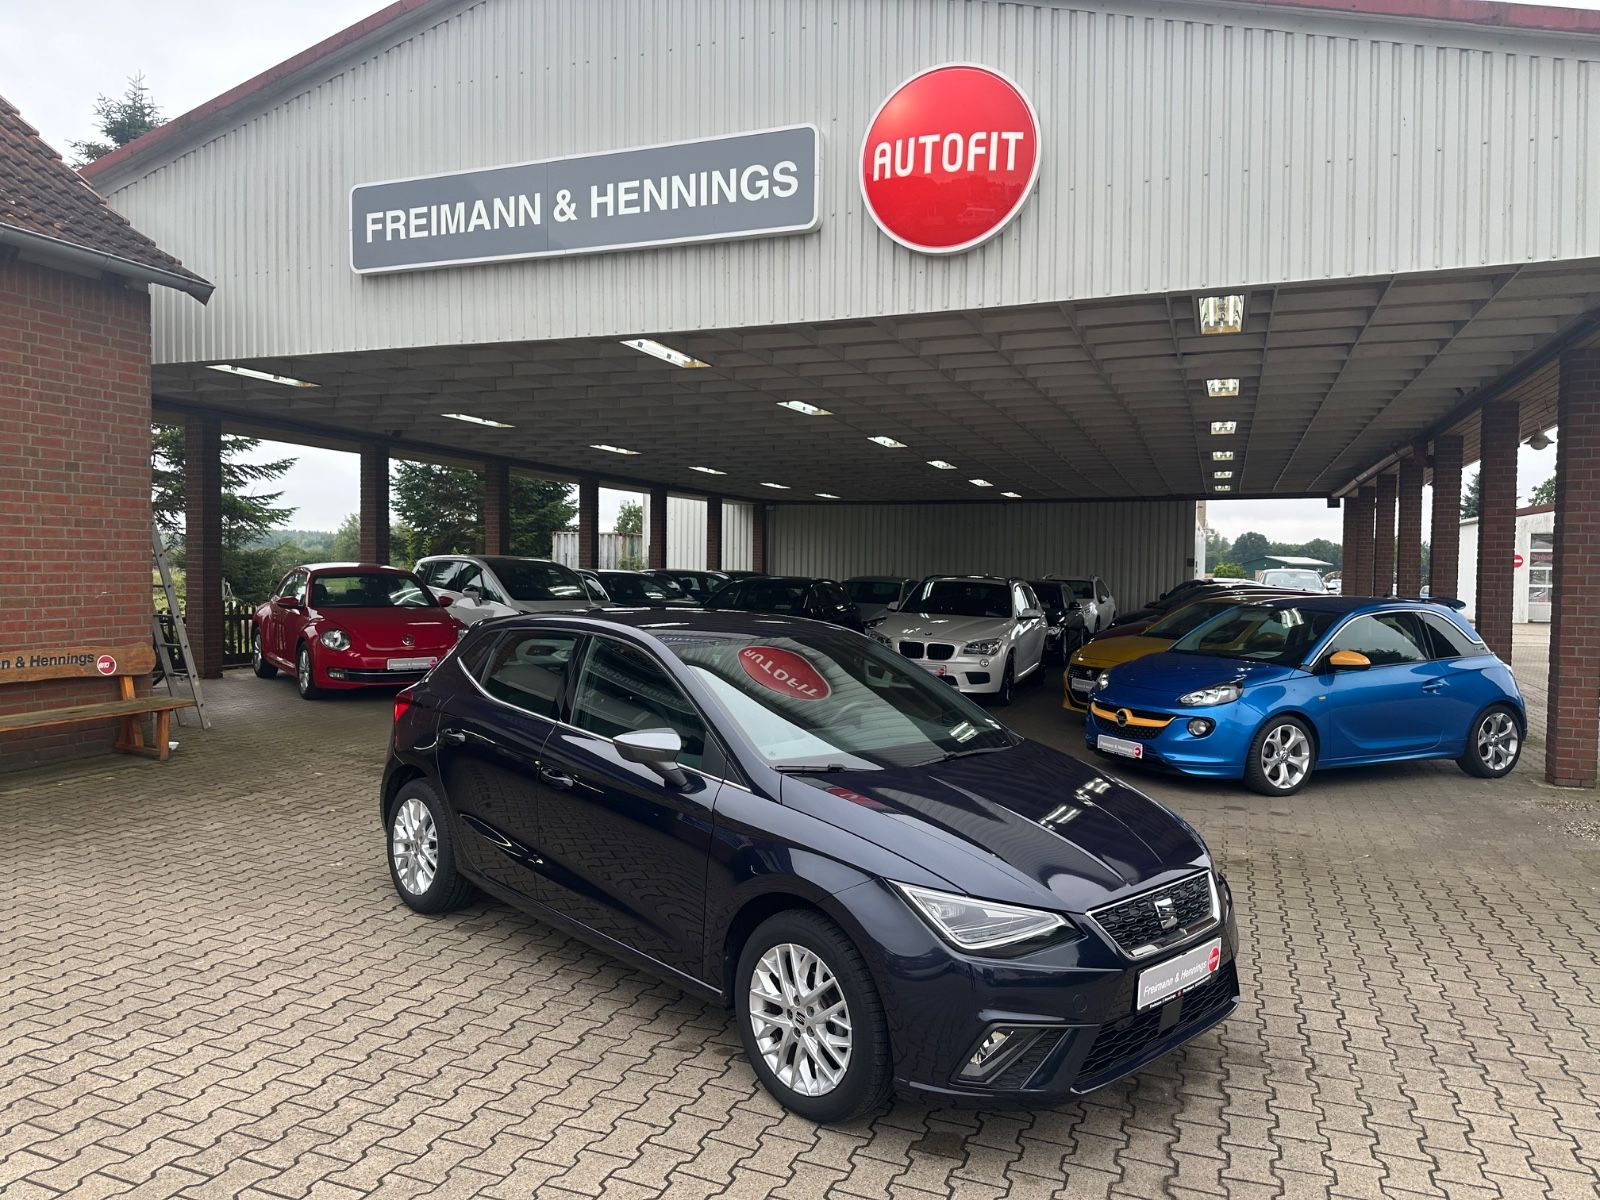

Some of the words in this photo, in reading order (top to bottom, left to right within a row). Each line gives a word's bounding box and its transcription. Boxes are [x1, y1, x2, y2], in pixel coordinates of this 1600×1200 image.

[873, 131, 1024, 182] AUTOFIT
[366, 192, 541, 243] FREIMANN
[553, 189, 578, 223] &
[590, 160, 799, 219] HENNINGS
[15, 656, 25, 669] &
[30, 653, 95, 667] Hennings
[1143, 977, 1174, 997] Freimann
[1174, 973, 1180, 983] &
[1180, 960, 1208, 980] Hennings
